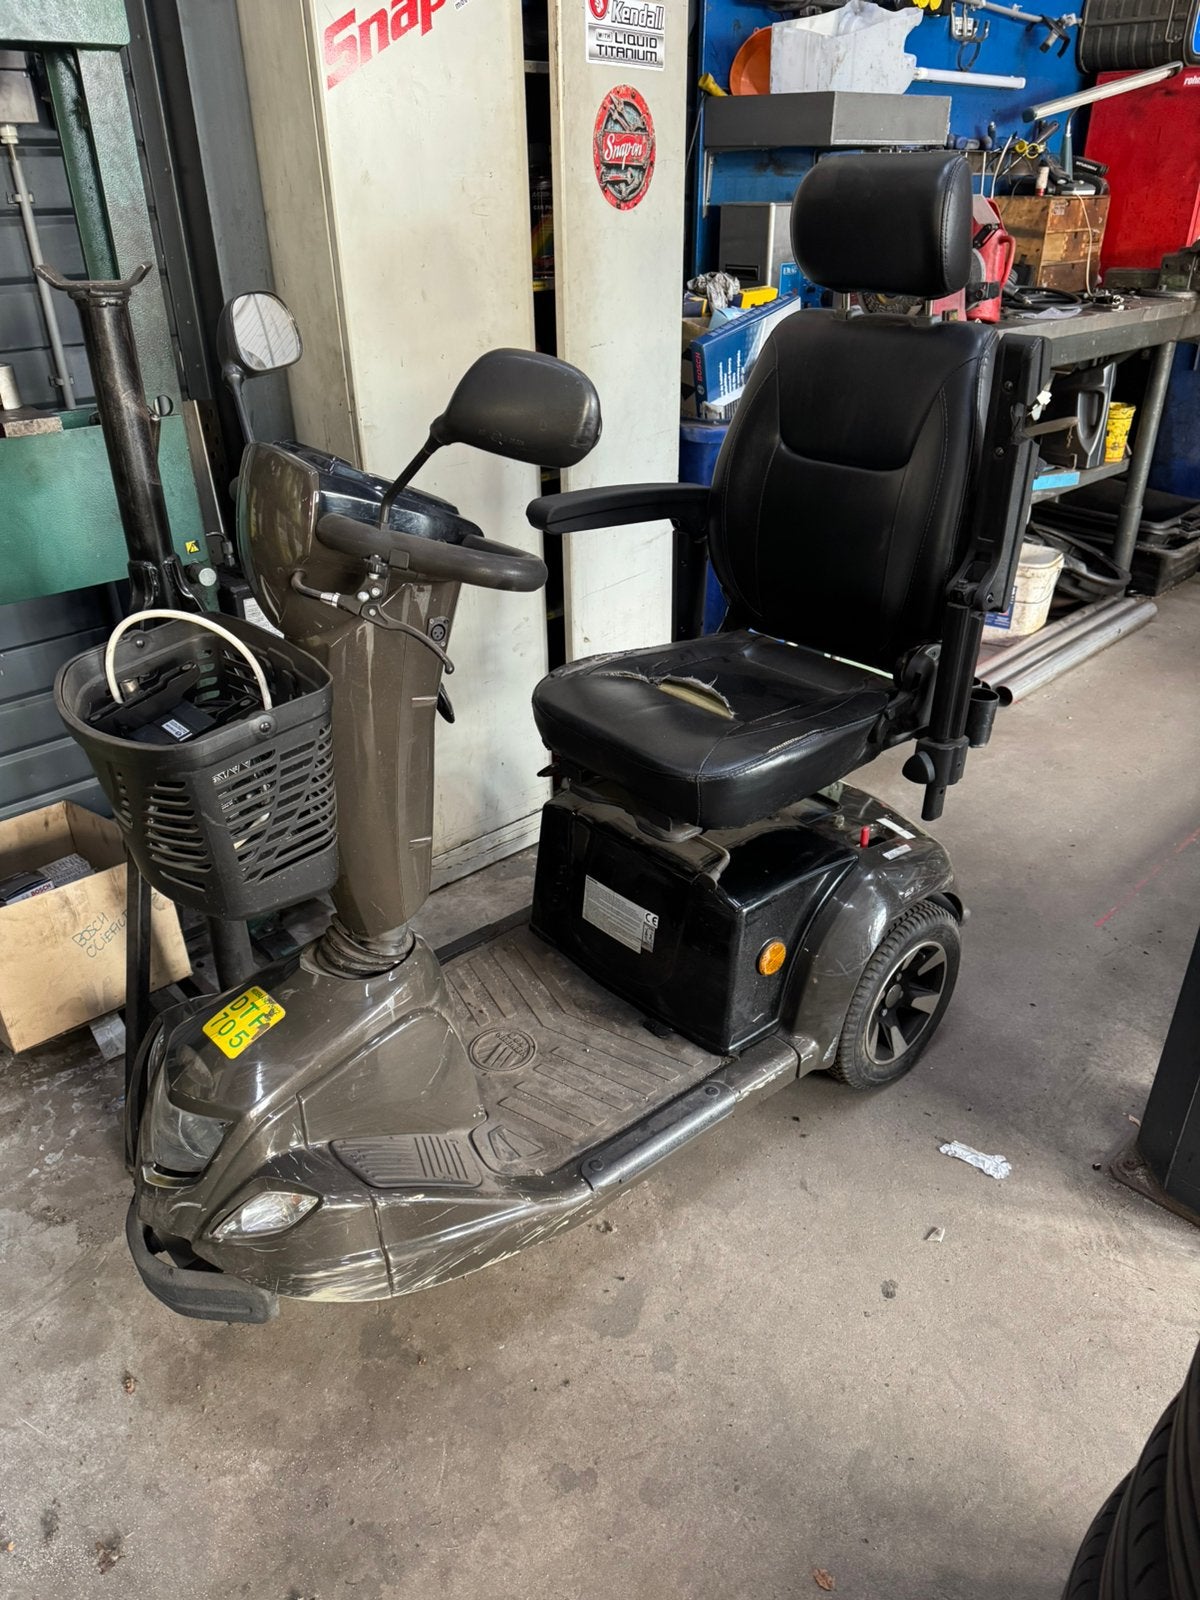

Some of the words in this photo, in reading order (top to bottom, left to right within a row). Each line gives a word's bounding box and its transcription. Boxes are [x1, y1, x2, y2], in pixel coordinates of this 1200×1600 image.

[611, 0, 664, 30] Kendall
[615, 32, 657, 48] LIQUID
[596, 44, 657, 62] TITANIUM
[30, 883, 52, 897] BOSCH
[72, 912, 109, 947] BOSCH
[210, 1012, 250, 1048] 705
